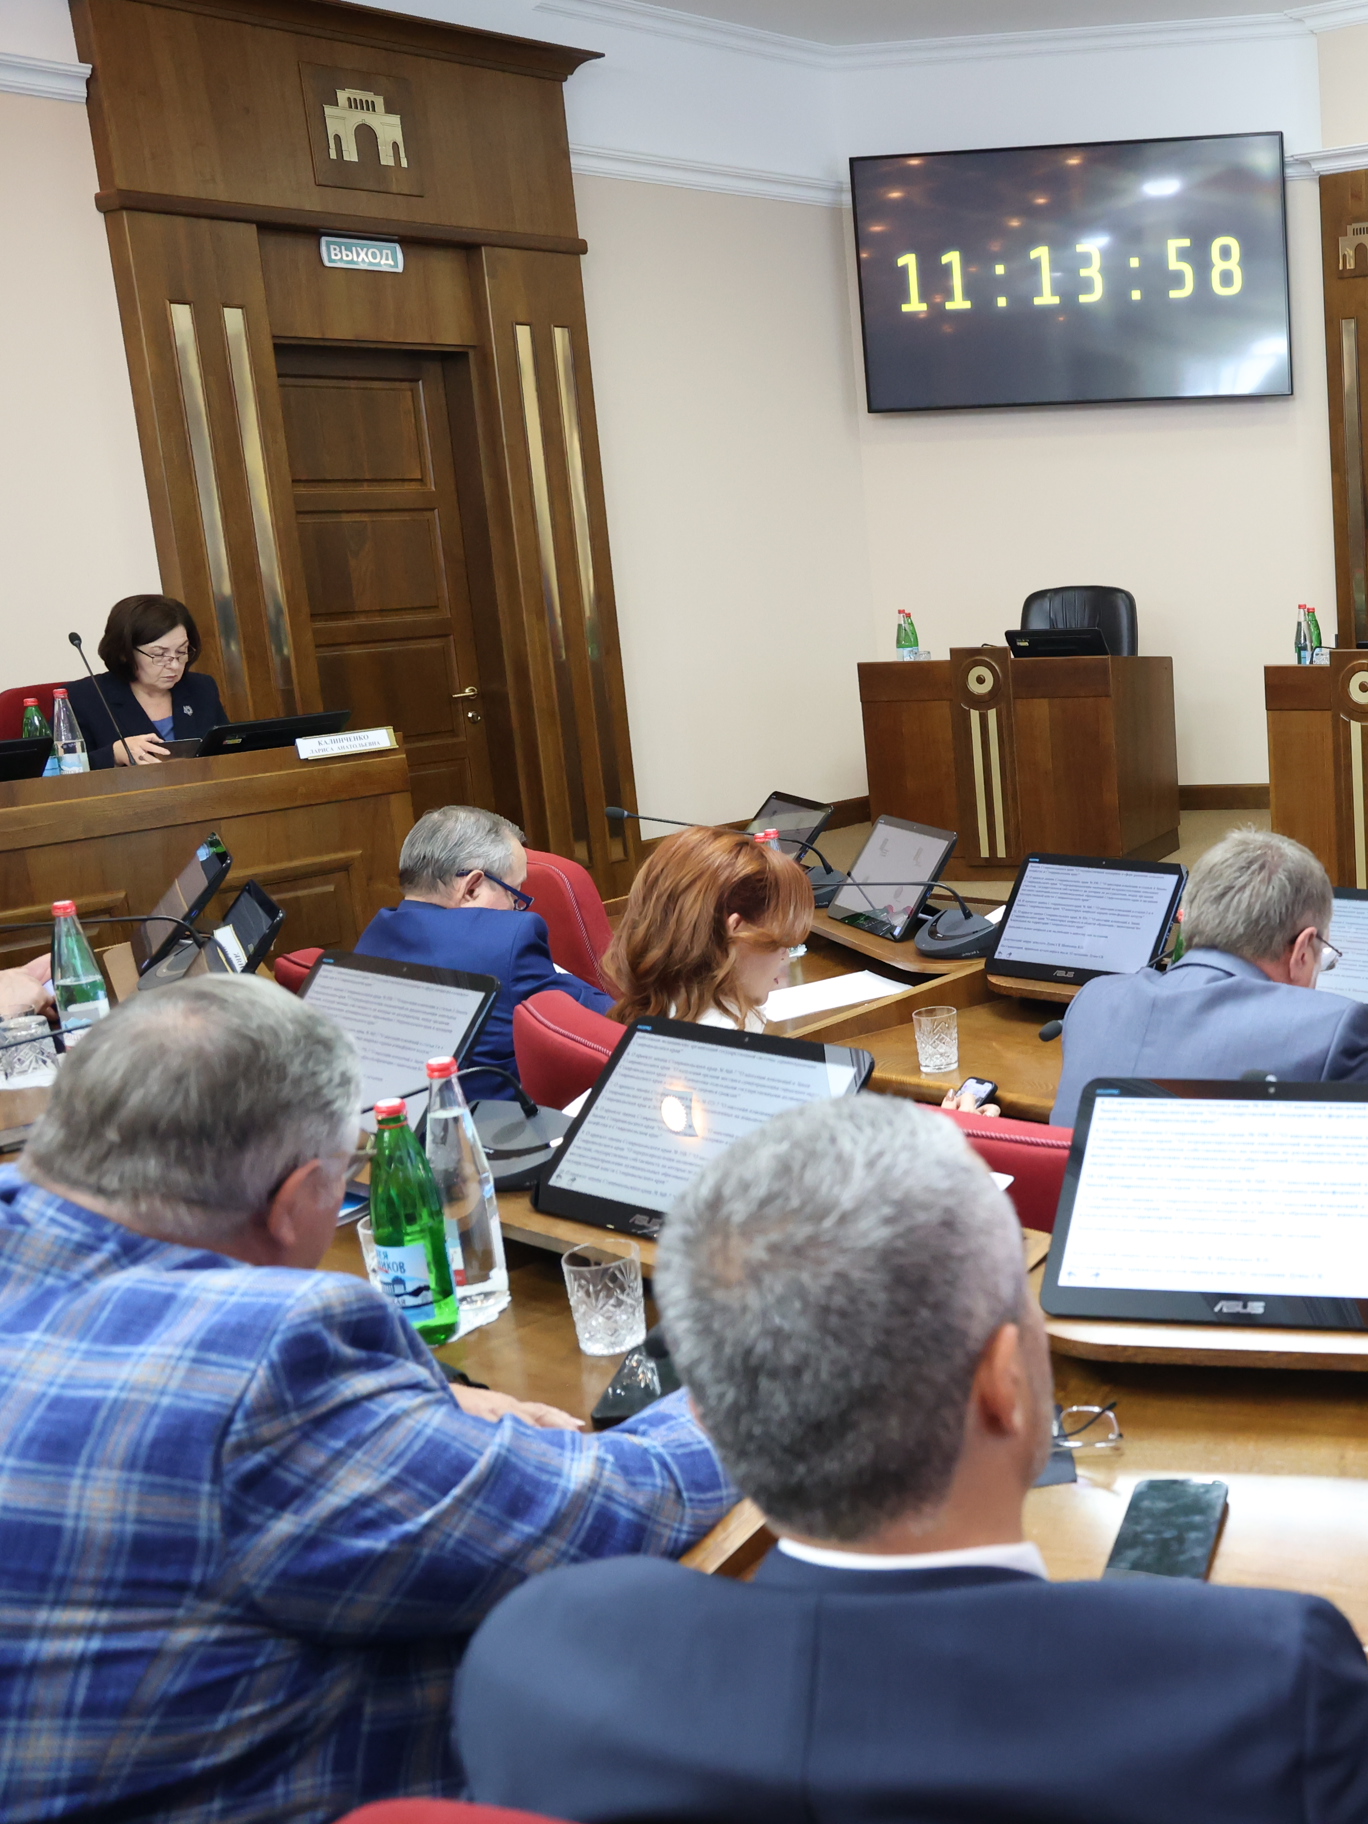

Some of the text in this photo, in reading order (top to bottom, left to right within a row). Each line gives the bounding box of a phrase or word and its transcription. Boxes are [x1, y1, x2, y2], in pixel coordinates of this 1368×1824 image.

[330, 245, 394, 265] ВЫХОД
[897, 236, 1243, 312] 11:13:58
[1213, 1300, 1266, 1315] ASUS
